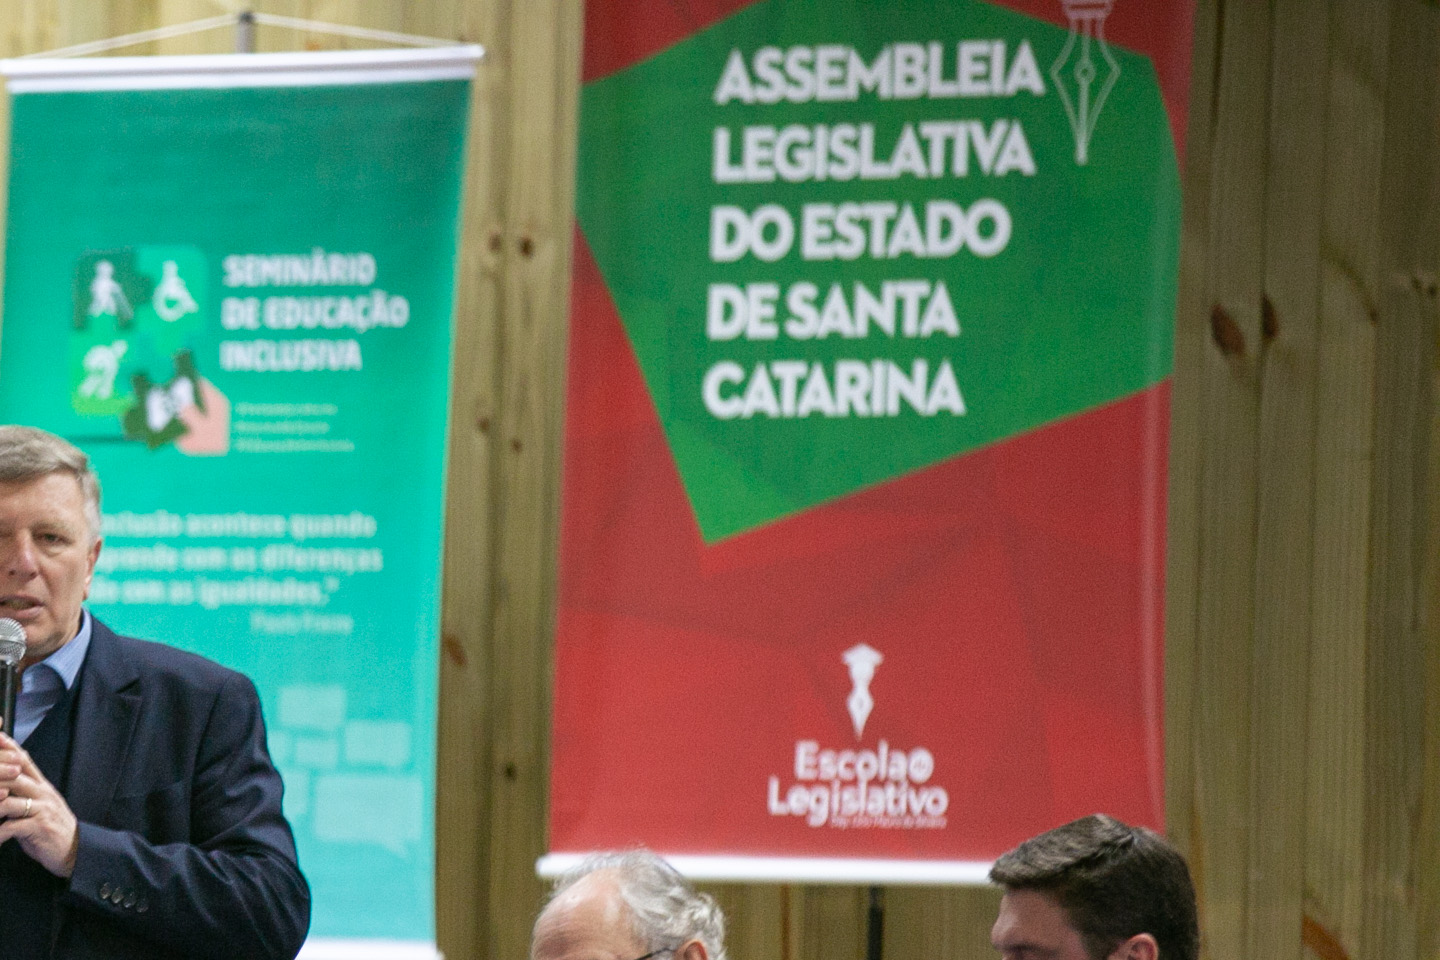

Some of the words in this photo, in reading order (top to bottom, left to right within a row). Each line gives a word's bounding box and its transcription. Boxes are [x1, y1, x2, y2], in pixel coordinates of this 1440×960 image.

[714, 39, 1046, 105] ASSEMBLEIA
[713, 119, 1037, 184] LEGISLATIVA
[709, 204, 795, 262] DO
[800, 198, 1013, 261] ESTADO
[222, 246, 378, 287] SEMINÁRIO
[221, 296, 260, 330] DE
[263, 288, 411, 334] EDUCAÇÃO
[706, 282, 779, 341] DE
[784, 279, 961, 339] SANTA
[219, 339, 364, 372] INCLUSIVA
[702, 357, 967, 419] CATARINA
[767, 774, 950, 828] Legislativo
